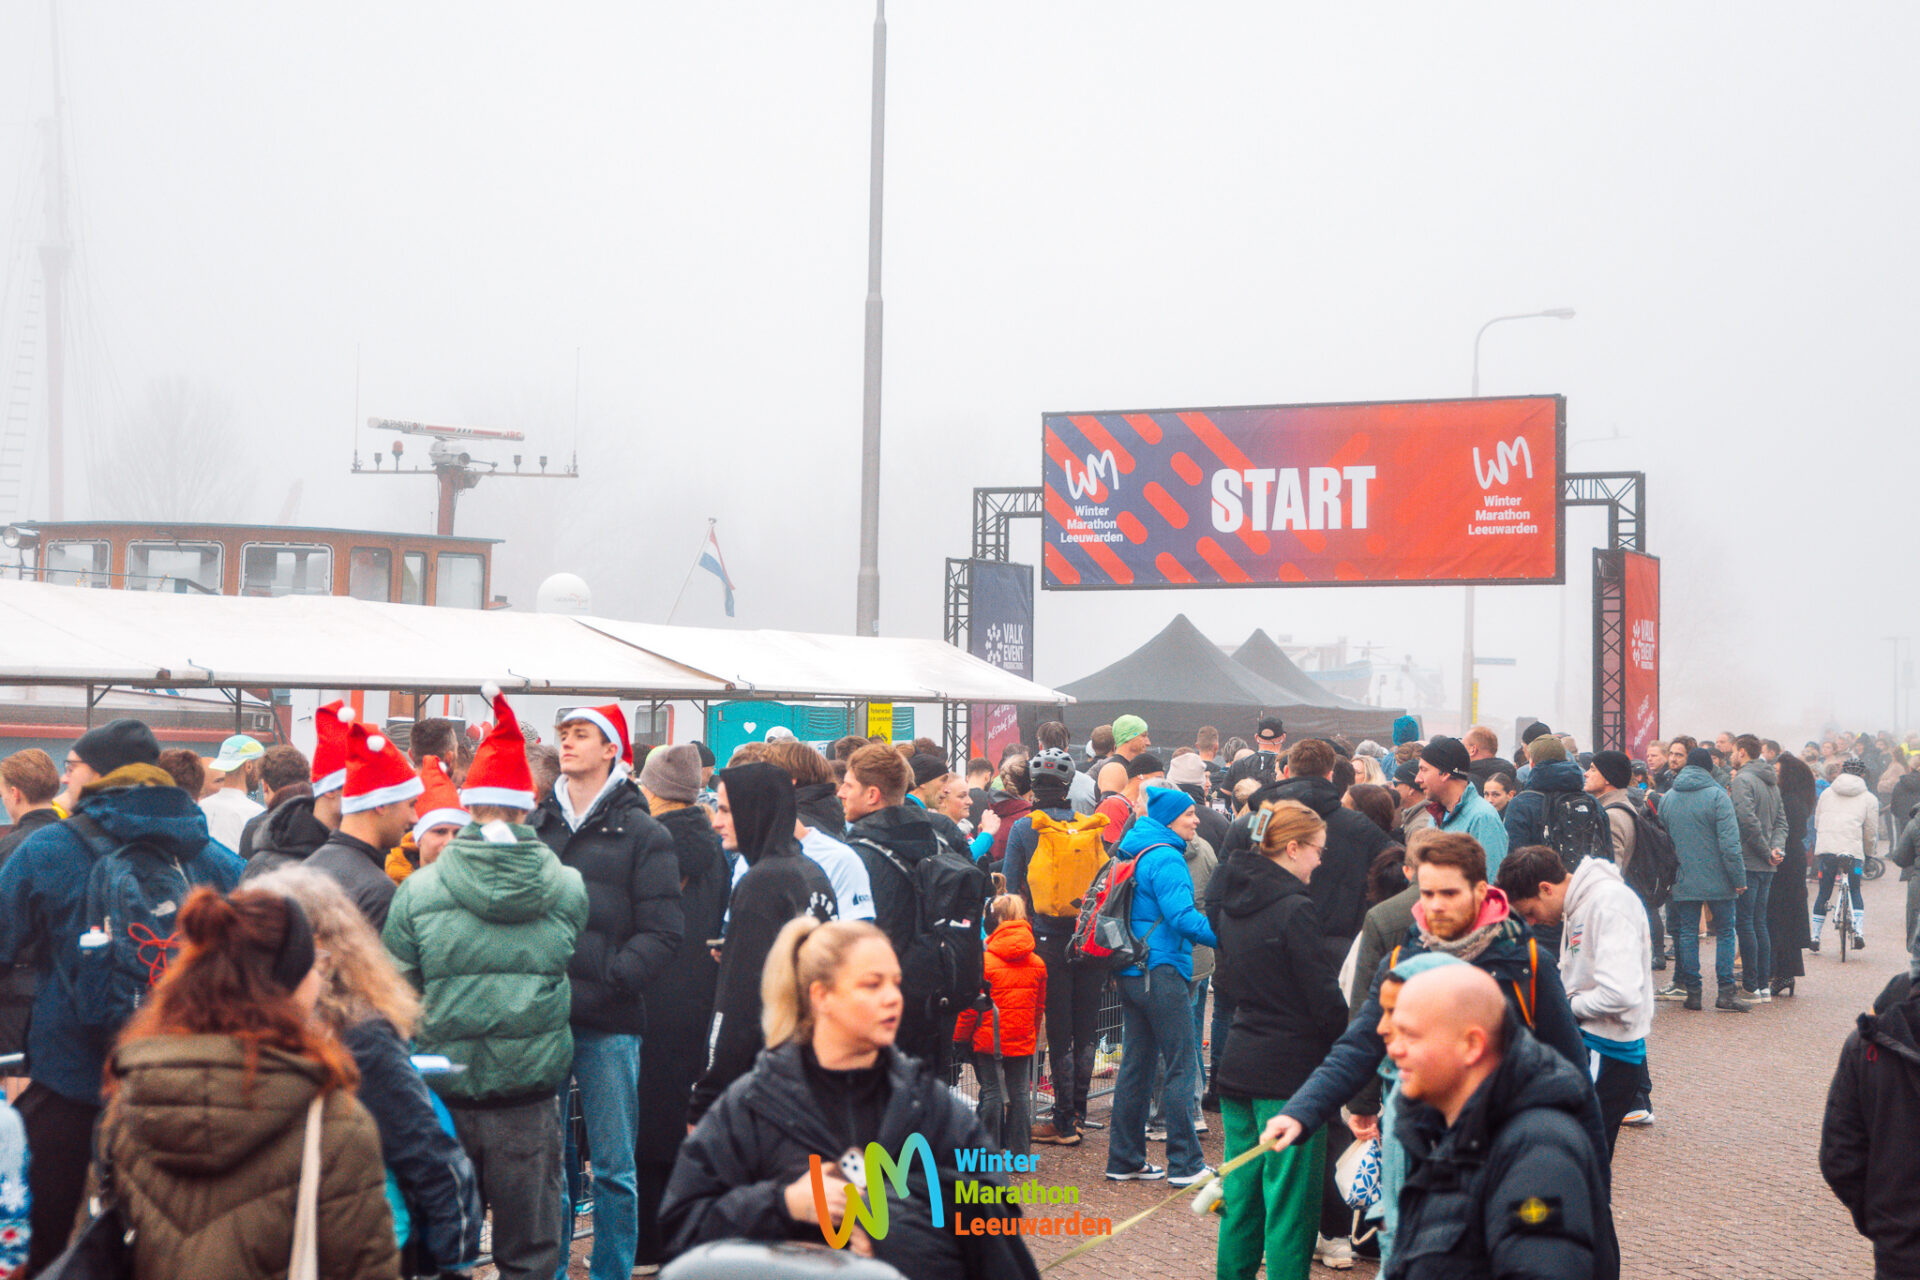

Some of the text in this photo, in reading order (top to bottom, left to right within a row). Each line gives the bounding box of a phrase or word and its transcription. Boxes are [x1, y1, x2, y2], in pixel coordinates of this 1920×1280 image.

[1211, 465, 1377, 533] START
[1484, 495, 1522, 507] Winter
[1075, 505, 1109, 516] Winter
[1475, 508, 1531, 521] Marathon
[1067, 518, 1117, 530] Marathon
[1468, 522, 1538, 535] Leeuwarden
[1060, 531, 1124, 543] Leeuwarden
[1003, 623, 1024, 645] VALK
[1003, 644, 1024, 662] EVENT
